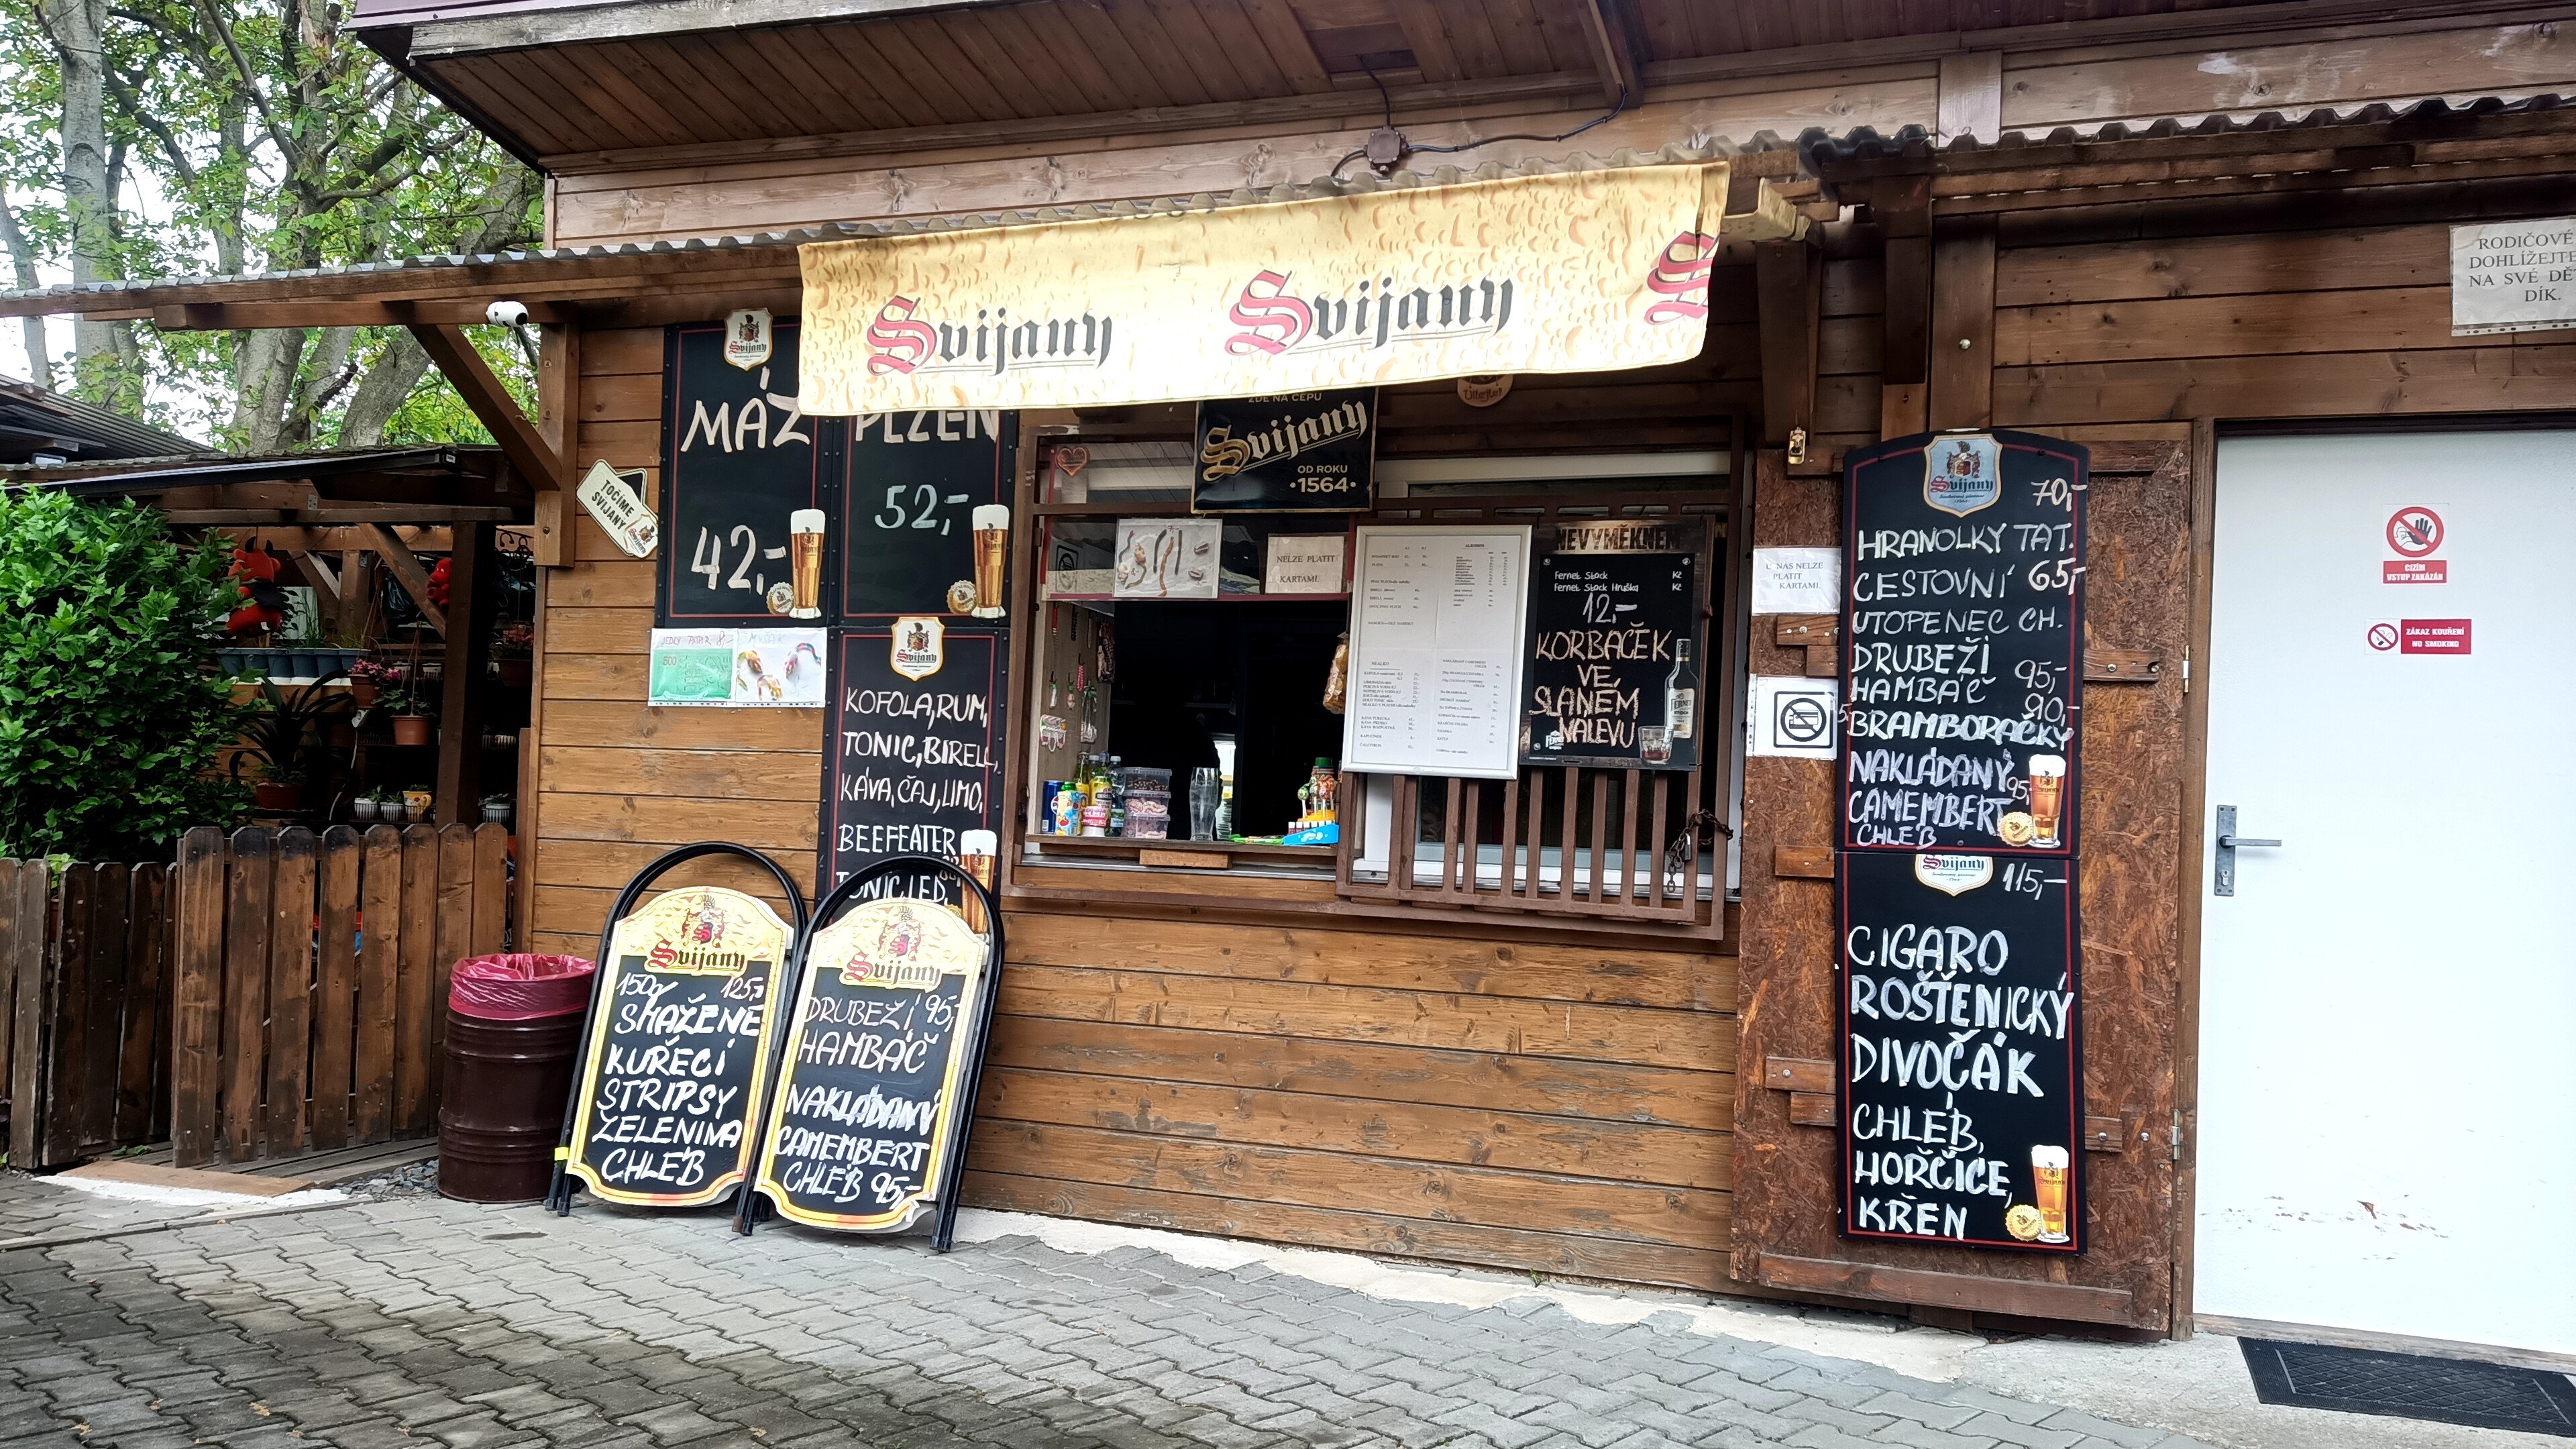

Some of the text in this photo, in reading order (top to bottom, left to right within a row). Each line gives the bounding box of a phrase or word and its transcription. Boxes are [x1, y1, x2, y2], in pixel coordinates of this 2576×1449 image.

[2479, 229, 2574, 250] RODIČOVÉ
[2469, 250, 2576, 268] DOHLÍŽEJTE
[2469, 266, 2576, 286] NA SVÉ DĚ
[2524, 286, 2561, 302] DÍK.
[1224, 269, 1513, 356] Svijany
[729, 340, 767, 354] Svijany
[867, 294, 1112, 376] Svijany
[681, 366, 810, 452] MÁZ
[1273, 394, 1289, 402] NA
[1200, 400, 1368, 483] Svijany
[1297, 464, 1348, 474] OD ROKU
[1930, 475, 1994, 493] Svijany
[592, 492, 627, 530] SVIJANY
[601, 479, 635, 518] TOČÍME
[875, 484, 969, 536] 52,-
[2031, 478, 2088, 512] 70,-
[1558, 524, 1678, 551] NEVYMĚKNEM
[1858, 523, 2074, 561] HRANOLKY TAT.
[692, 525, 787, 596] 42,-
[1277, 555, 1335, 563] NELZE PLATIT
[1555, 570, 1682, 580] Fernet Stock Kč
[1776, 561, 1794, 570] NÁS
[1795, 561, 1824, 570] NELZE
[2404, 563, 2426, 572] CIZÍM
[1280, 575, 1320, 583] KARTAMI.
[1554, 582, 1682, 592] Fernet Stock Hruška Kč
[1854, 558, 2087, 602] CESTOVNÍ 65,-
[2386, 572, 2444, 581] VSTUP ZAKÁZÁN
[1582, 592, 1638, 624] 12,-
[1853, 606, 2064, 635] UTOPENEC CH.
[2406, 627, 2465, 635] ZÁKAZ KOUŘENÍ
[896, 649, 937, 663] Svijany
[1851, 636, 1990, 674] DRUBEŽÍ
[2015, 659, 2068, 694] 95,-
[1849, 747, 2015, 793] NAKLÁDANÝ
[1849, 790, 2014, 837] CAMEMBERT
[837, 824, 957, 856] BEEFEATER
[1923, 855, 1984, 871] Svijany
[647, 938, 745, 972] Svijany
[1847, 923, 2008, 976] CIGARO
[844, 951, 941, 987] Svijany
[604, 1035, 735, 1077] KUŘECÍ
[798, 1028, 939, 1074] HAMBÁČ
[1851, 1029, 2045, 1097] DIVOČÁK
[596, 1077, 738, 1116] STRIPSY
[786, 1085, 942, 1136] NAKLÁDANÝ
[776, 1125, 930, 1172] CAMEMBERT
[1860, 1191, 1967, 1241] KŘEN
